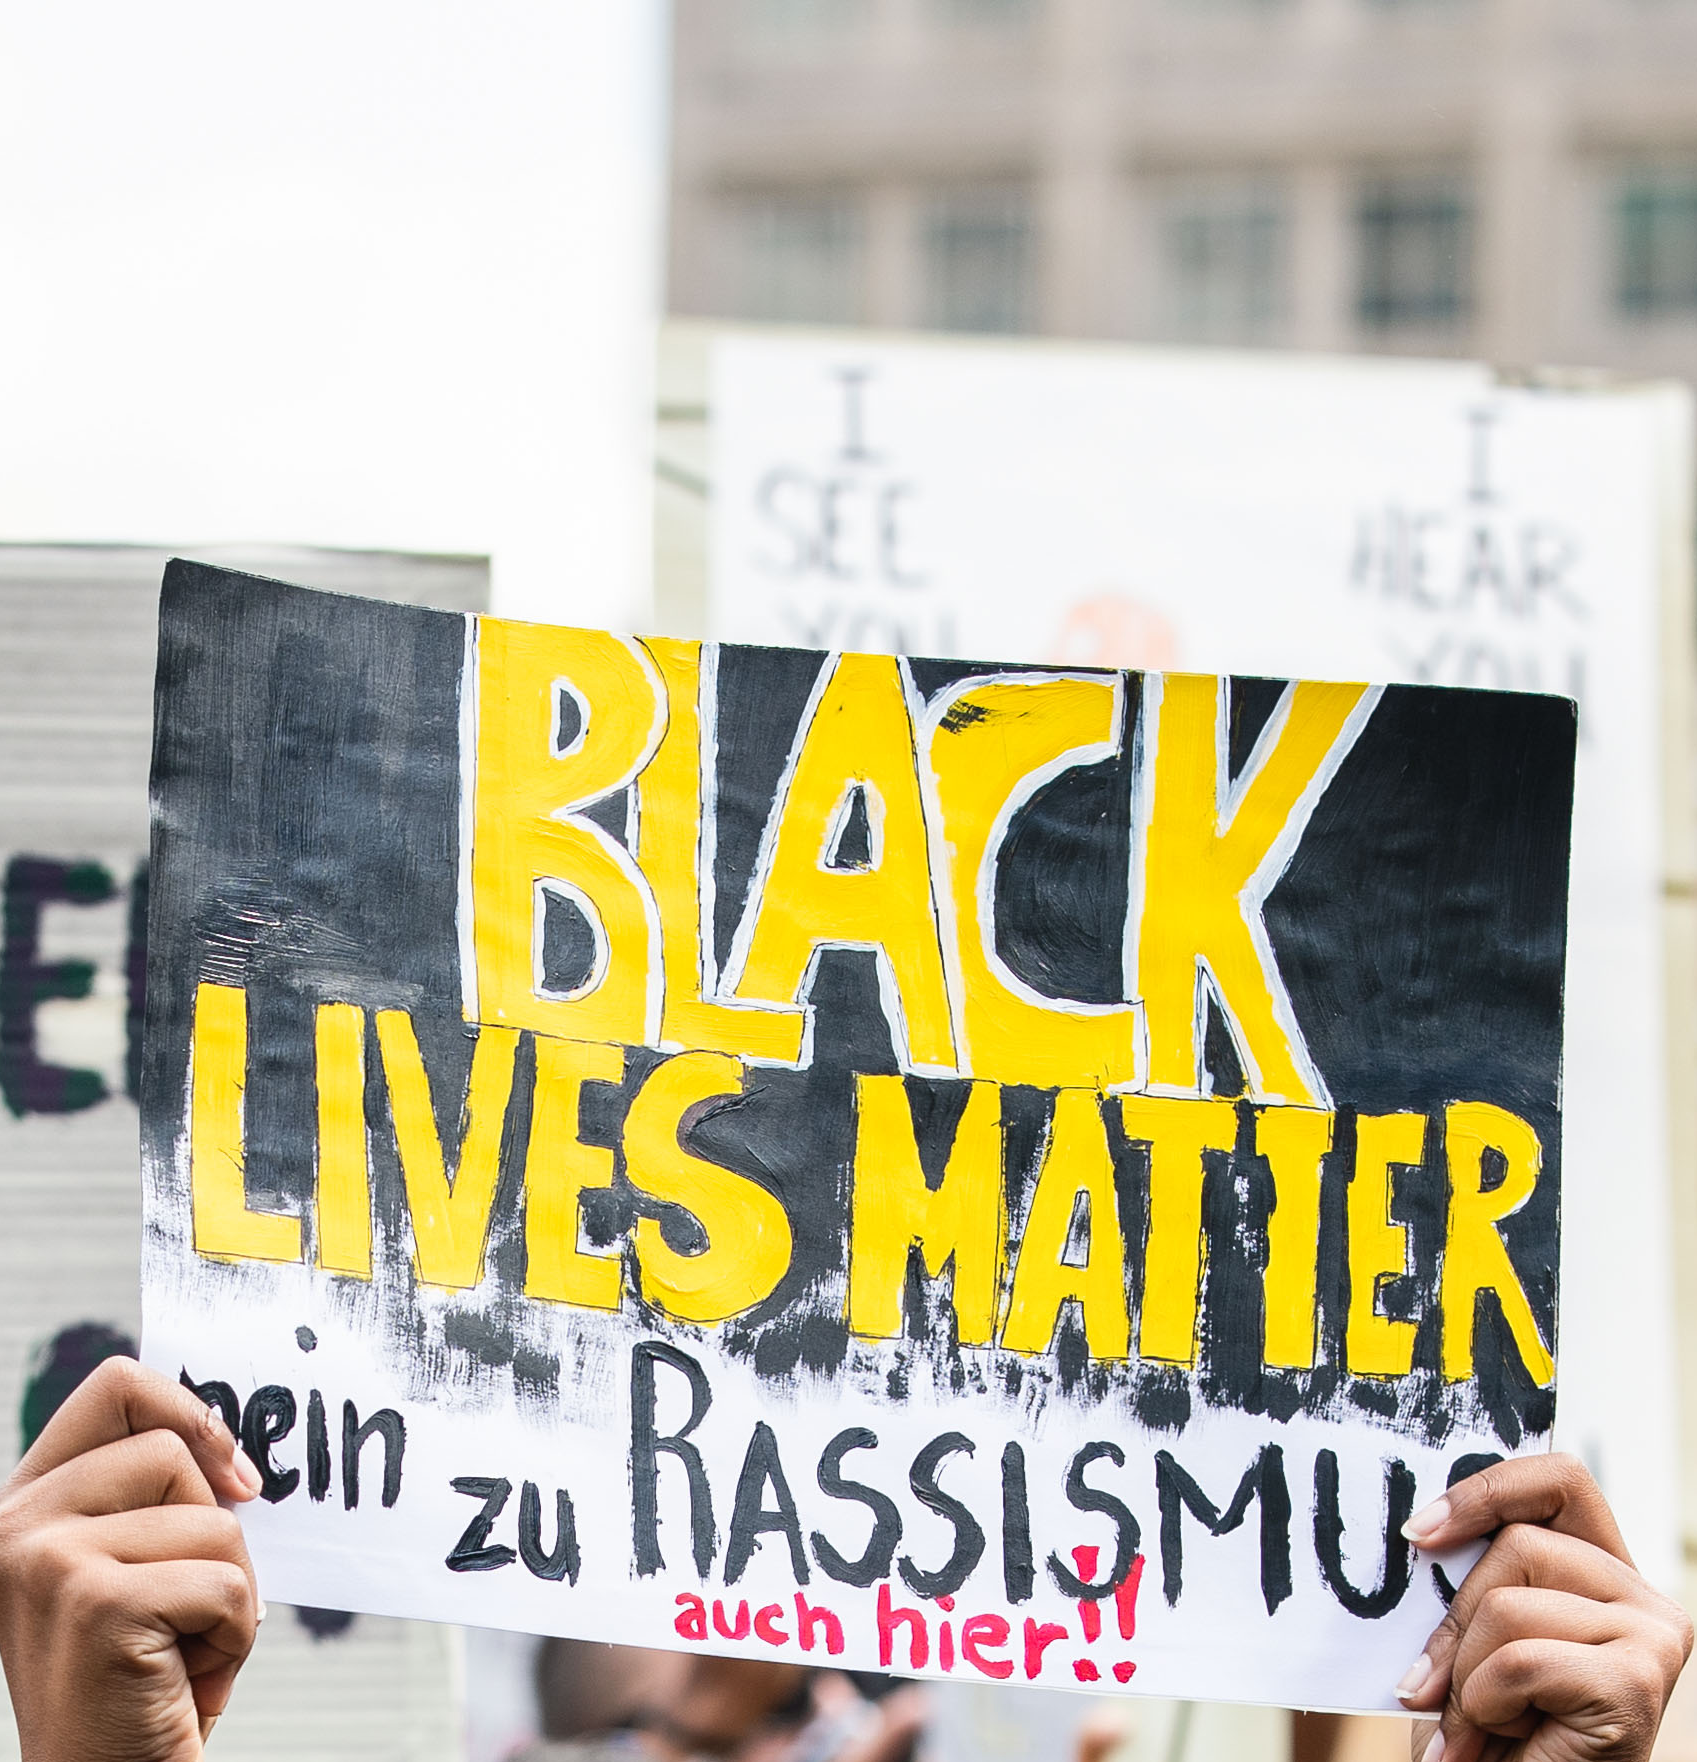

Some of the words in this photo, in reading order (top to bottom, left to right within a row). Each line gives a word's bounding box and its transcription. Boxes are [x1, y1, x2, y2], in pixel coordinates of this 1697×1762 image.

[827, 366, 881, 463] I
[1460, 407, 1502, 505] I
[754, 467, 927, 590] SEE
[1345, 498, 1588, 620] HEAR
[457, 611, 1387, 1110] BLACK
[190, 981, 796, 1326] LIVES
[848, 1074, 1558, 1386] MATTER
[444, 1476, 582, 1588] zu
[674, 1591, 846, 1656] auch
[876, 1545, 1145, 1685] hier!!
